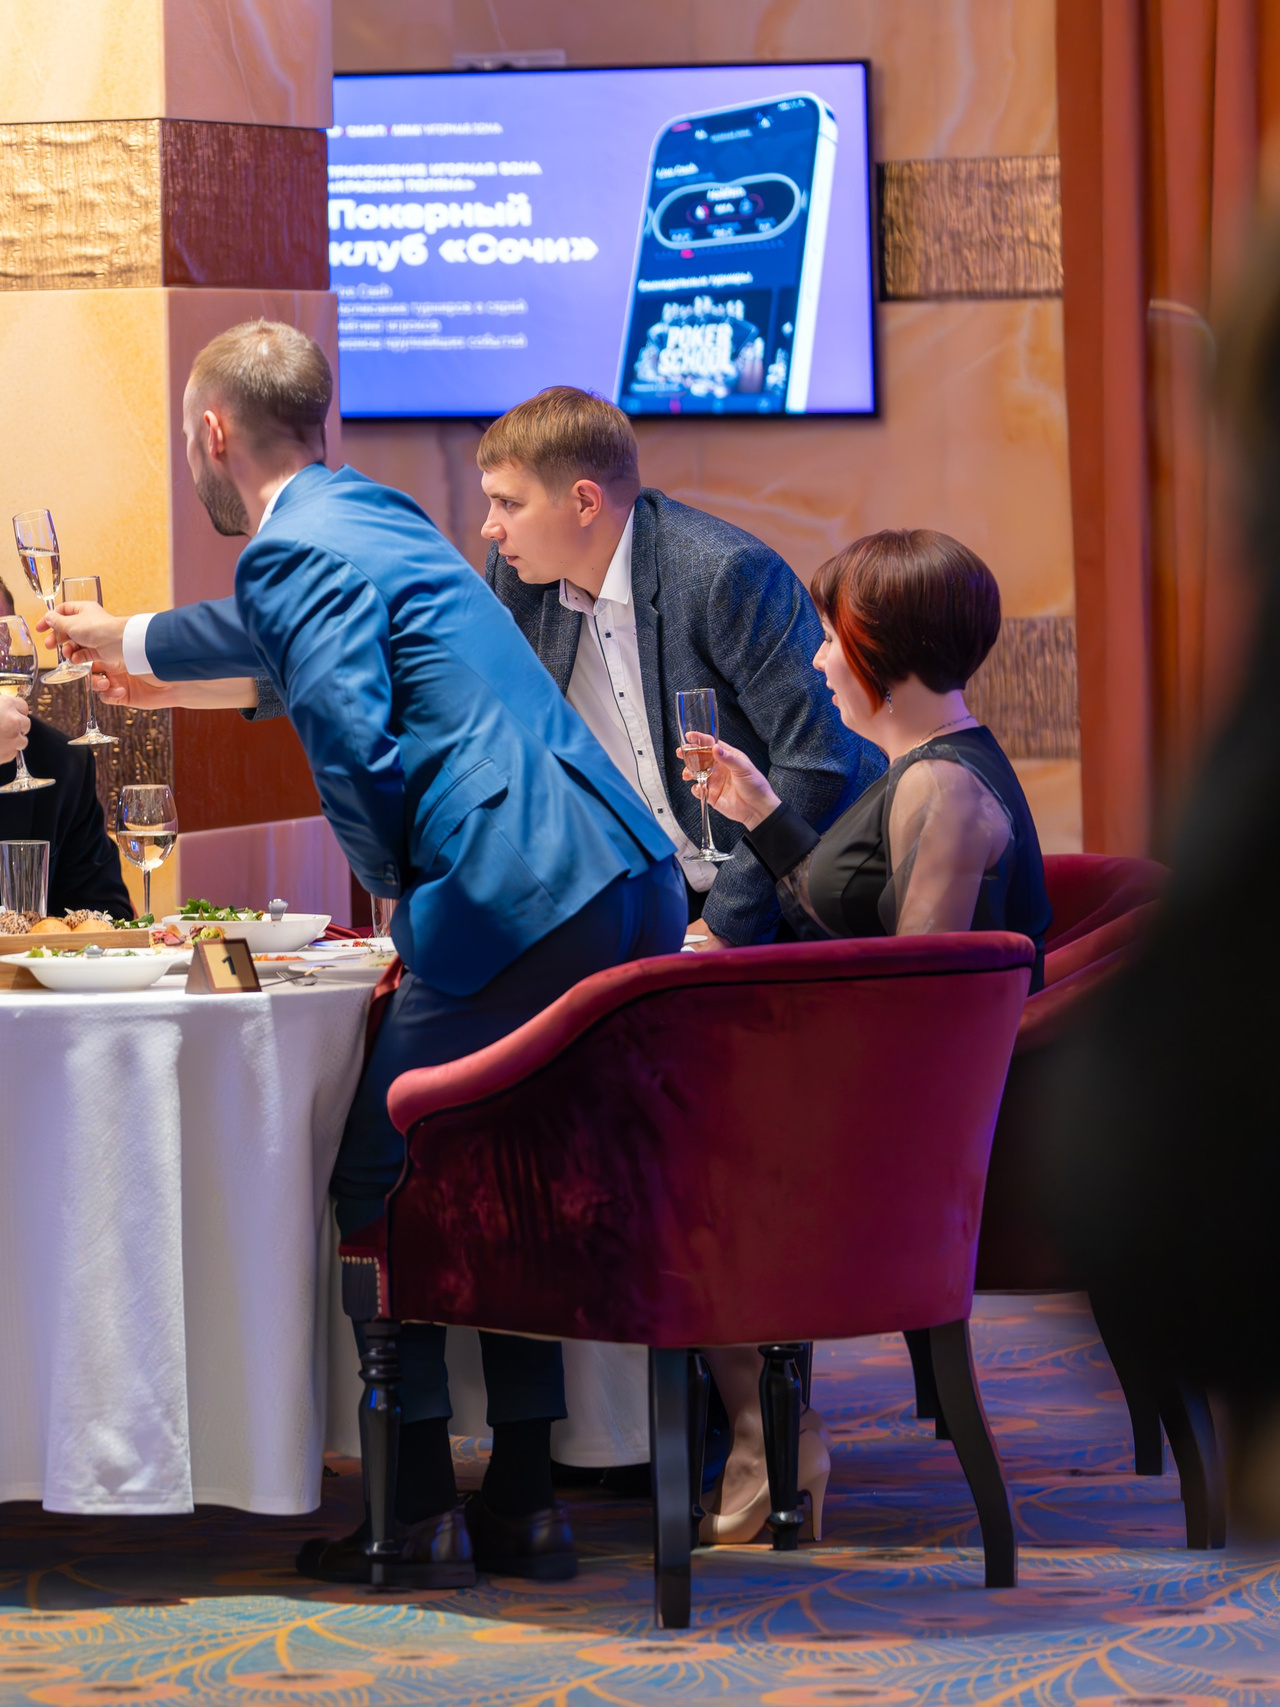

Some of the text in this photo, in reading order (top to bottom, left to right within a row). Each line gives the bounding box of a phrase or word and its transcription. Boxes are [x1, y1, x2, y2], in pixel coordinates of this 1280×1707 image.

[328, 192, 532, 235] Покерный
[328, 232, 599, 272] клуб «Сочи»
[666, 323, 733, 350] POKER
[658, 347, 734, 375] SCHOOL
[222, 955, 237, 976] 1
